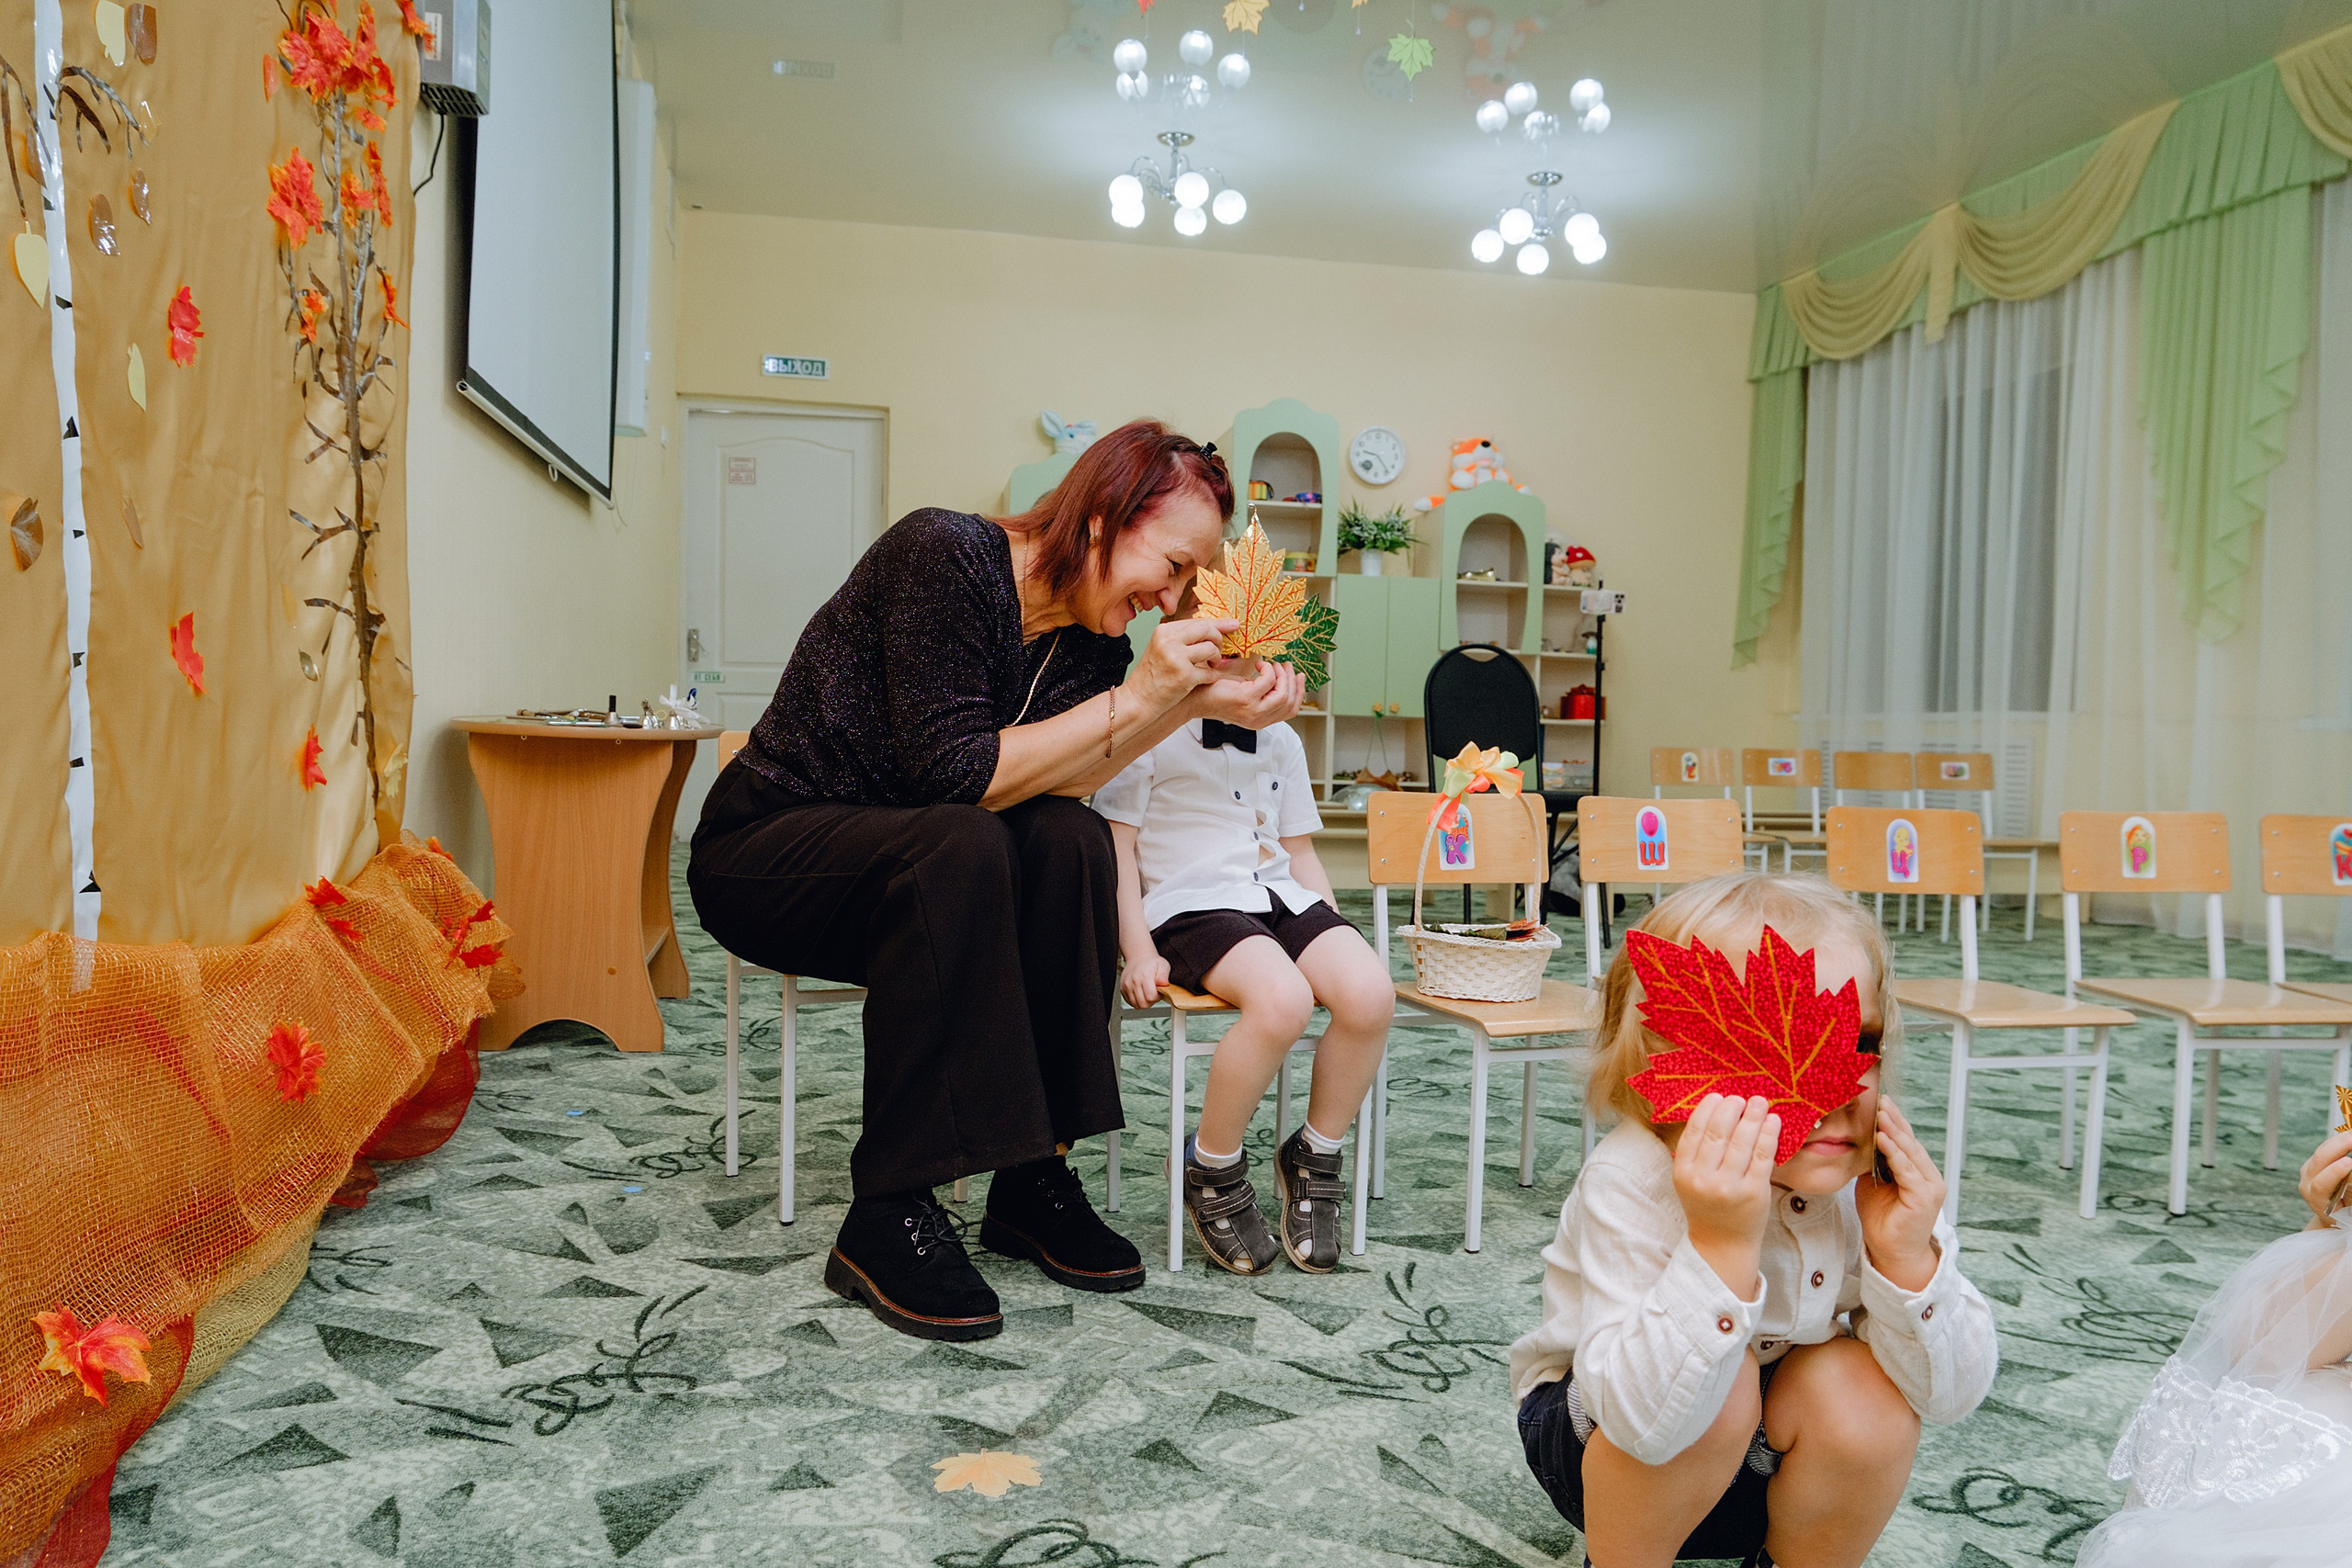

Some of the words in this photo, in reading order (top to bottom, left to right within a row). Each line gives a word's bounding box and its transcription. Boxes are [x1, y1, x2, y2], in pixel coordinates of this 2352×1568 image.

[769, 358, 823, 376] ВЫХОД
[1639, 840, 1665, 865] Ш
[1891, 850, 1910, 878] Ц
